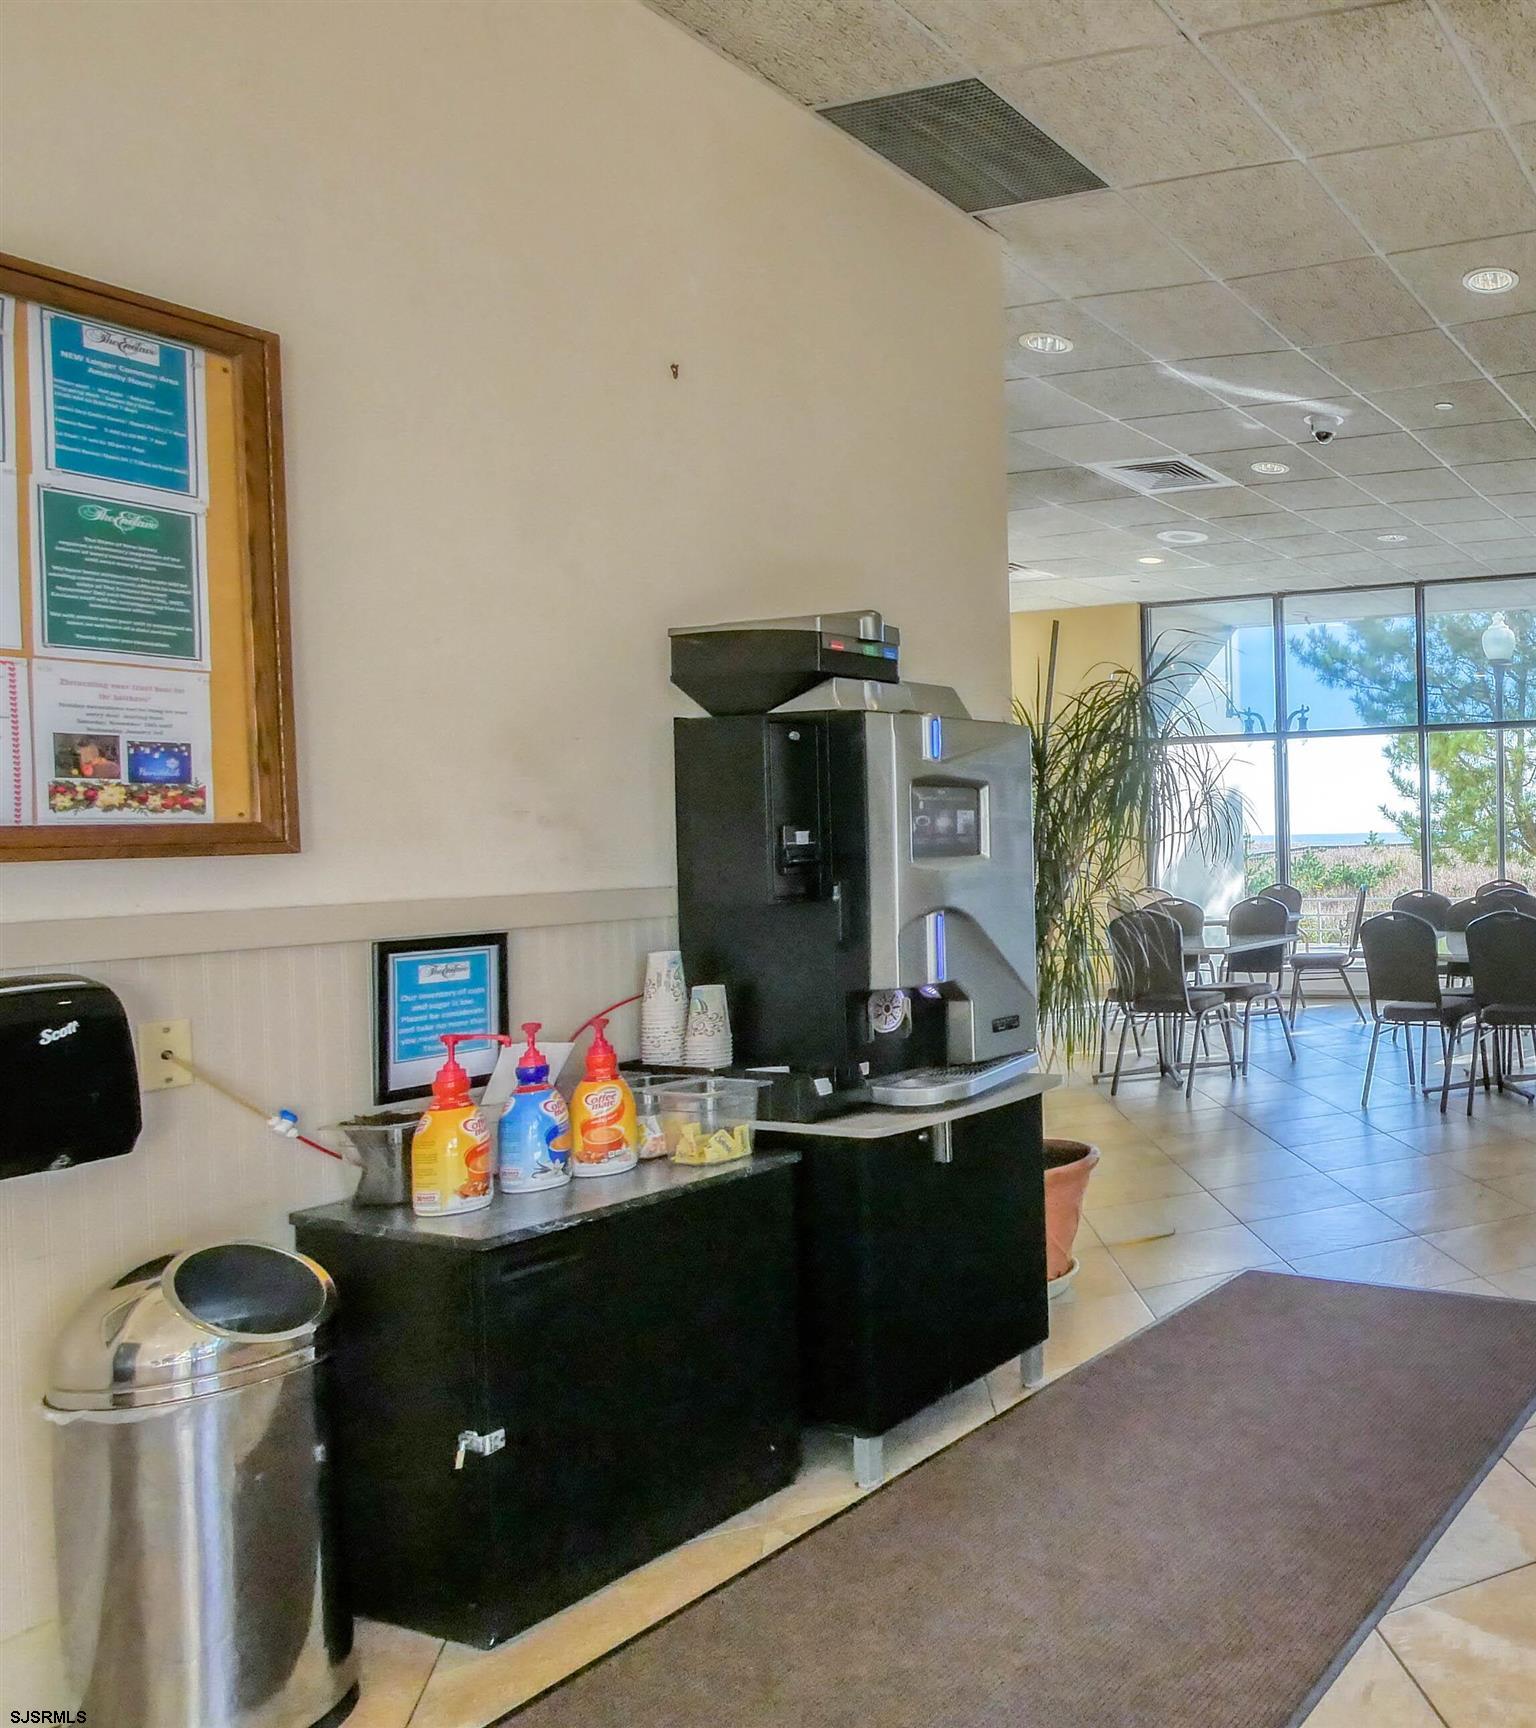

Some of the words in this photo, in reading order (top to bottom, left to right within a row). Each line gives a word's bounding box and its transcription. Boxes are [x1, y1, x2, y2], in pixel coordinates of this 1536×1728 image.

[39, 1020, 81, 1046] Scott
[585, 1090, 617, 1106] Coffee
[591, 1100, 616, 1111] mate
